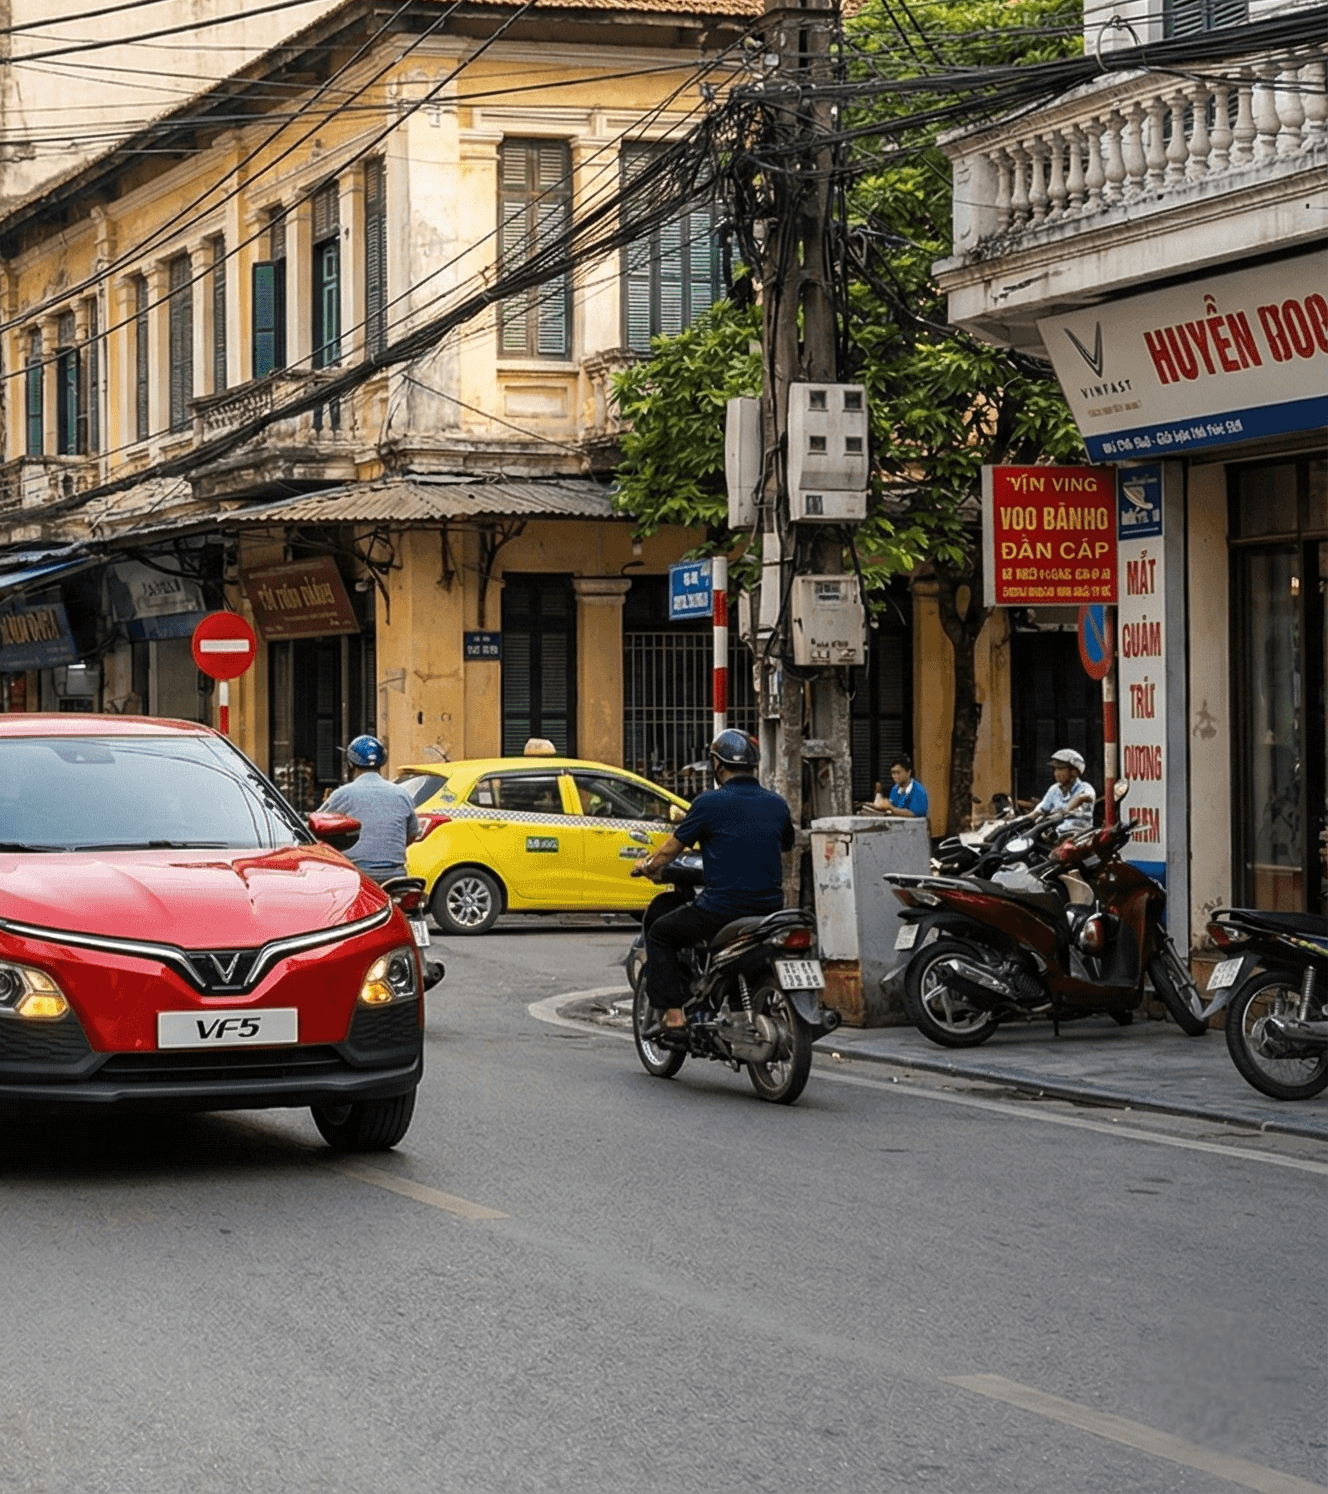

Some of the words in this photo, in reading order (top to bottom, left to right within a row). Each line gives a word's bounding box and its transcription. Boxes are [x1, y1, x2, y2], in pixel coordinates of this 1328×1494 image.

[1080, 379, 1132, 399] VINFAST
[1051, 477, 1097, 492] VING
[196, 1016, 262, 1040] VF5
